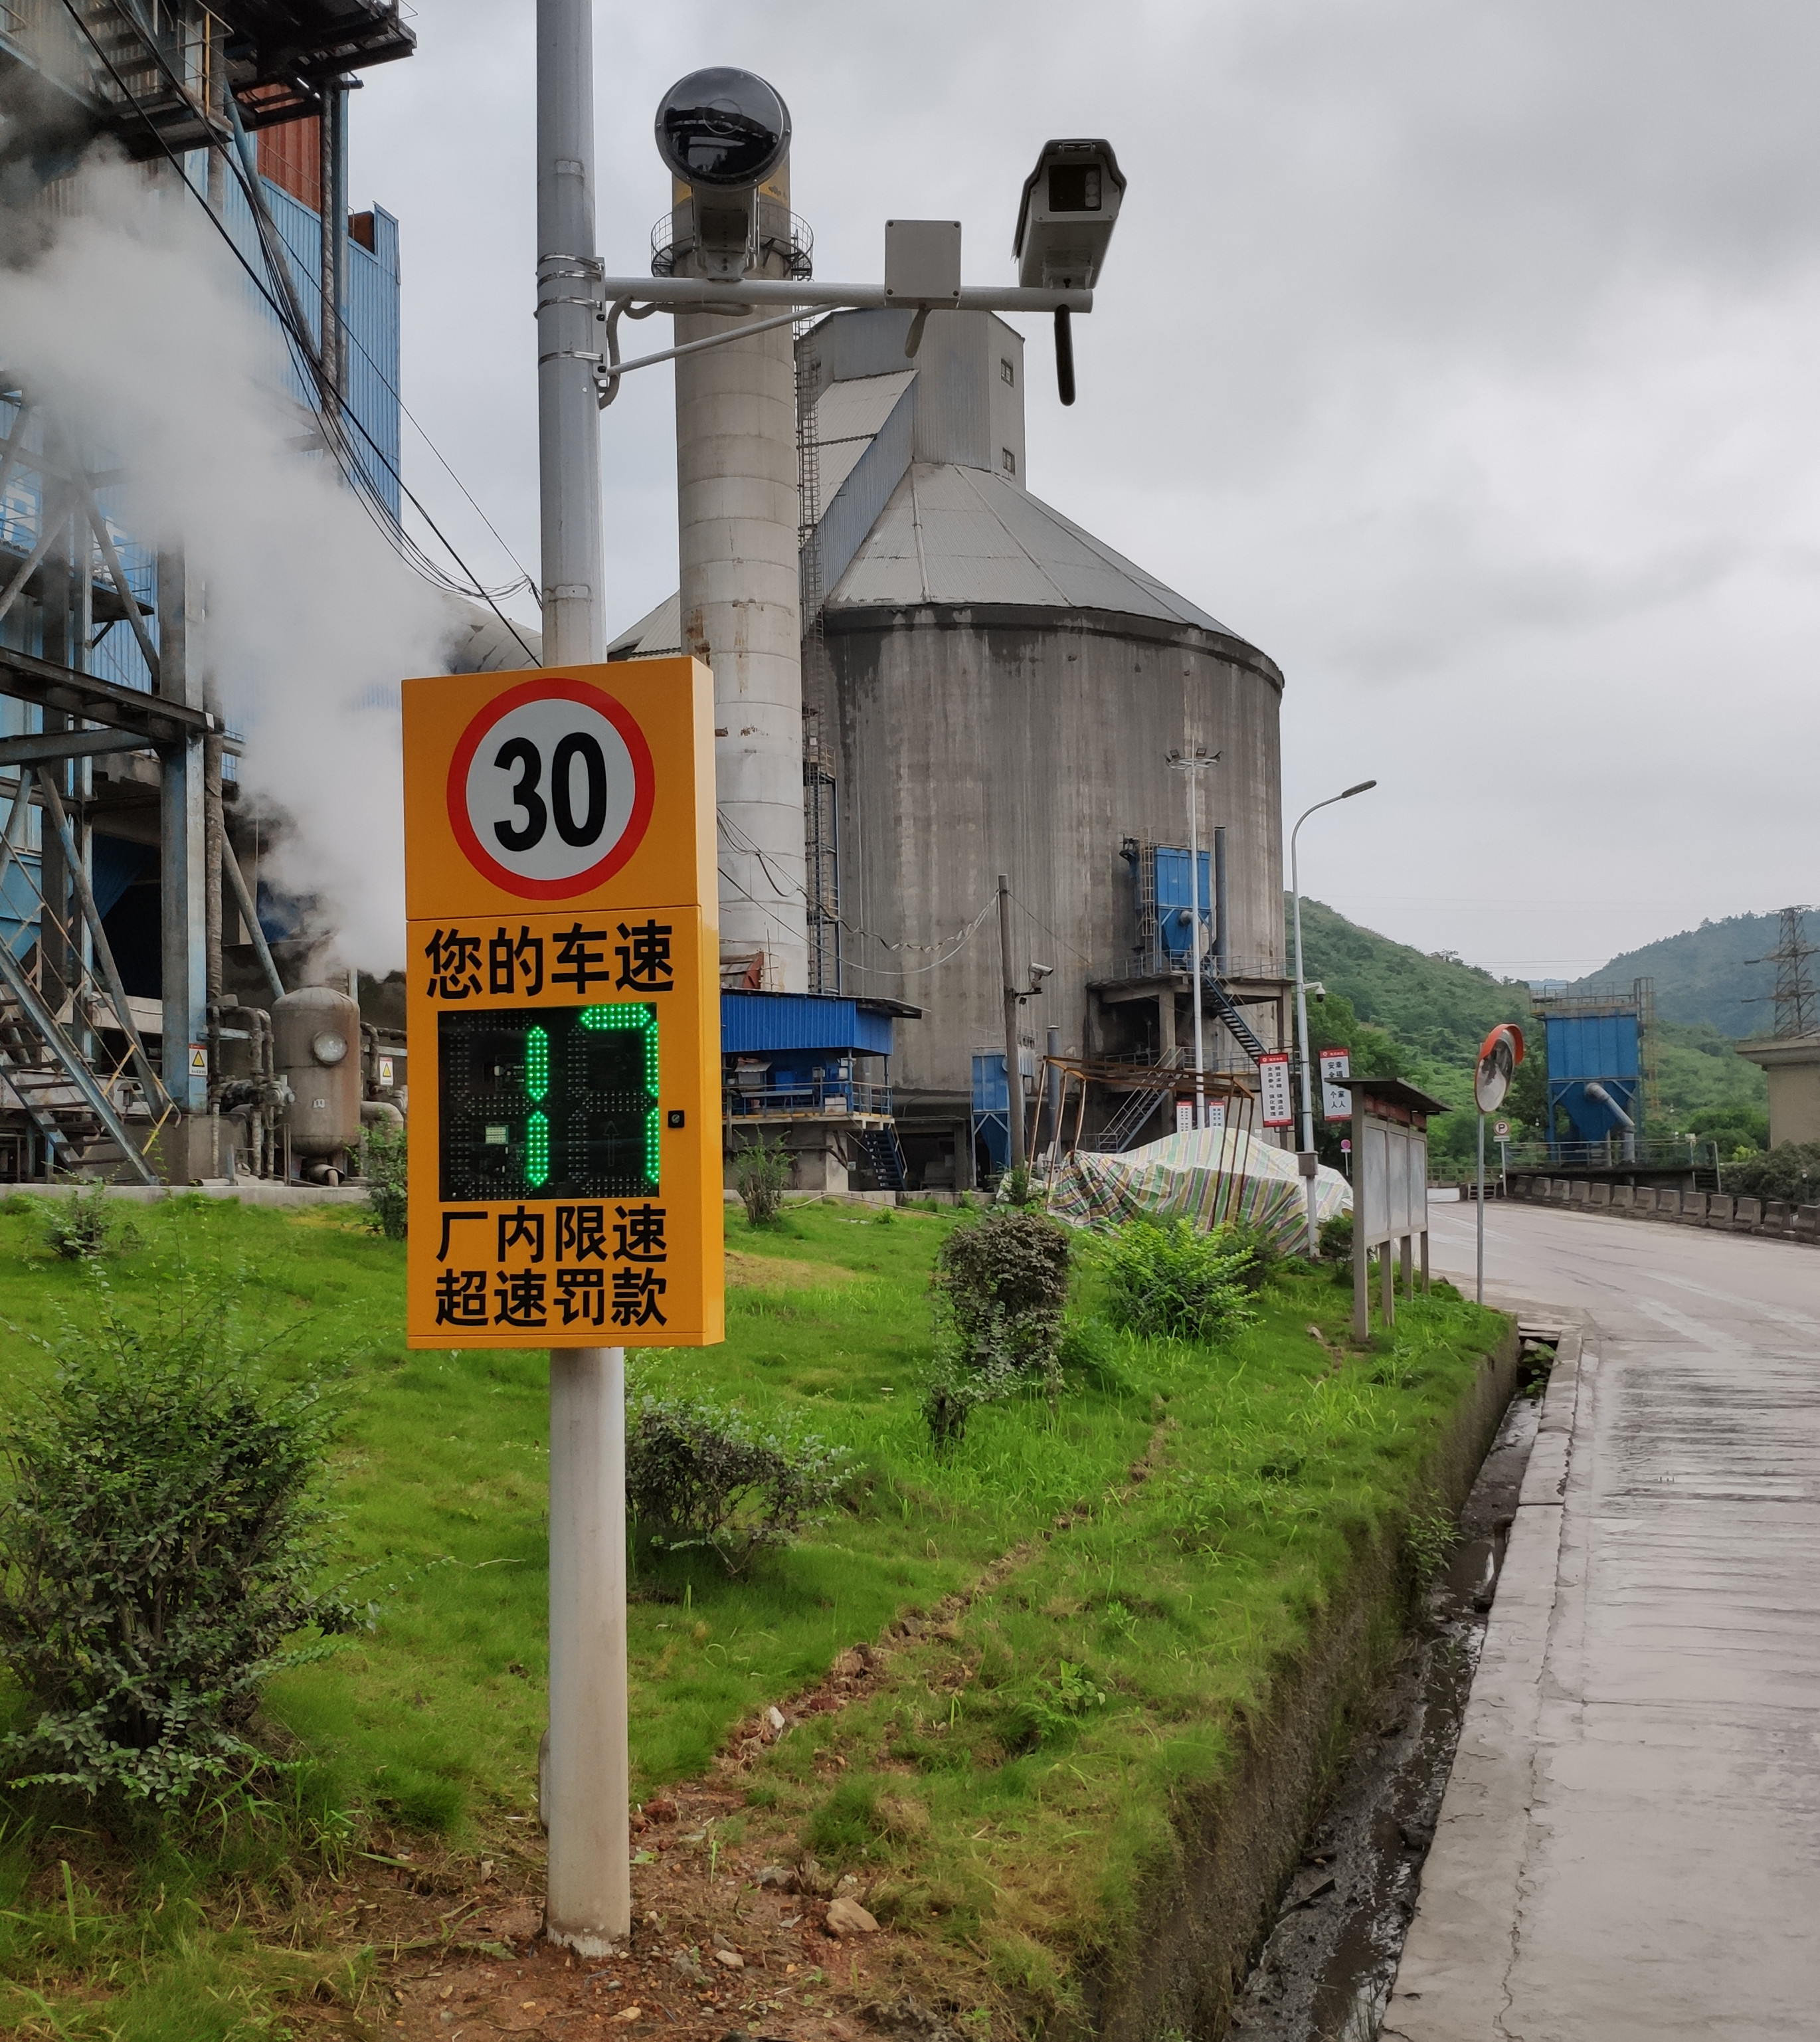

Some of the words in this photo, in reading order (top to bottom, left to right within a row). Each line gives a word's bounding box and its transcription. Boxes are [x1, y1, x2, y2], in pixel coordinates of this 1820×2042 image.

[494, 732, 607, 852] 30
[425, 918, 675, 1000] 您的车速
[525, 1003, 660, 1188] 17
[436, 1205, 667, 1263] 厂内限速
[436, 1267, 667, 1327] 超速罚款
